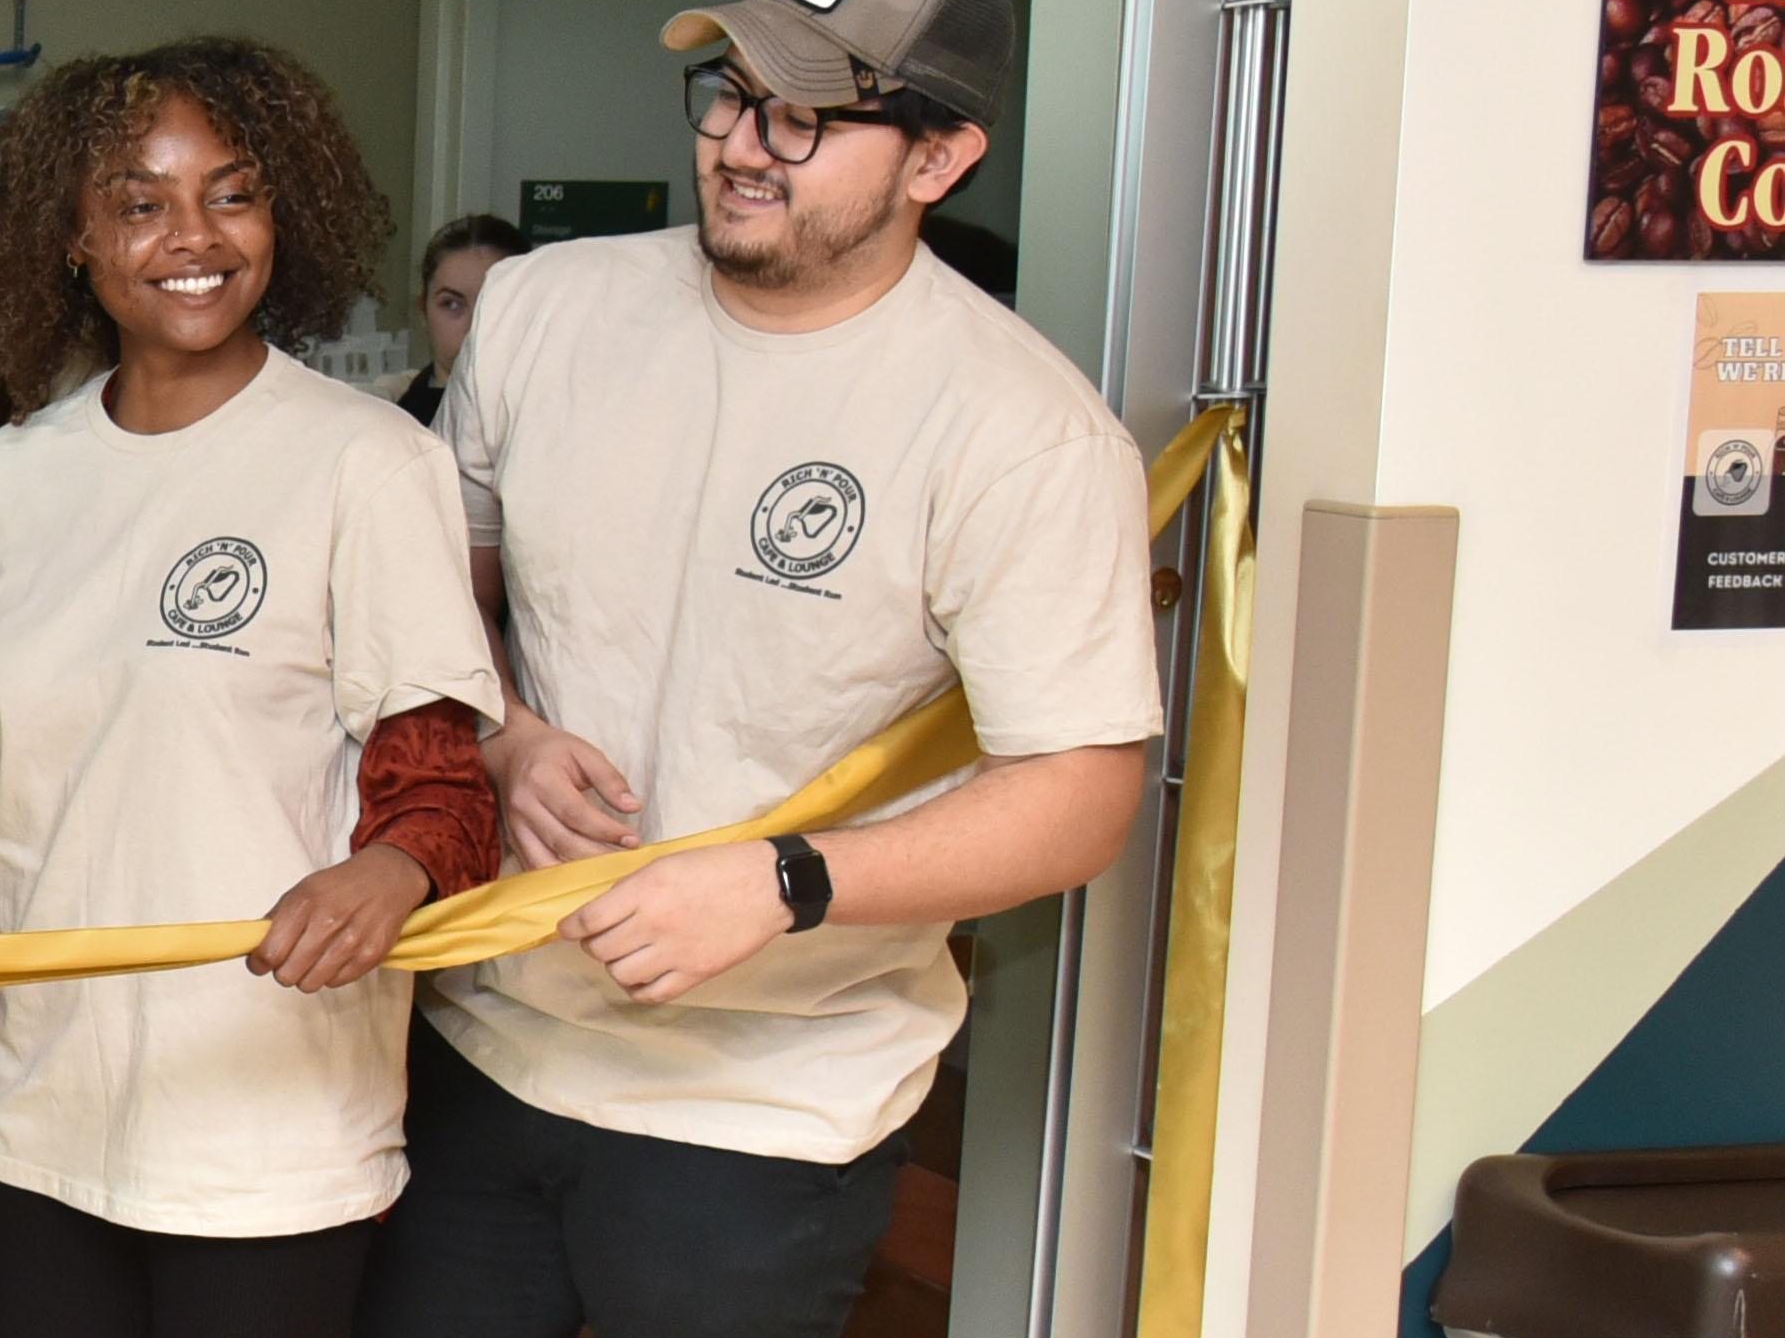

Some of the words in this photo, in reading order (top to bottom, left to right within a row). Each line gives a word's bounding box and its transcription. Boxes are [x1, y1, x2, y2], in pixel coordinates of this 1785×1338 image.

[533, 184, 564, 201] 206
[1719, 336, 1784, 358] TELL
[781, 469, 813, 490] RICH
[833, 473, 858, 504] POUR
[233, 544, 258, 568] POUR
[757, 537, 778, 564] CAFE
[788, 552, 837, 573] LOUNGE
[1707, 550, 1785, 566] CUSTOMER
[1707, 573, 1783, 590] FEEDBACK
[197, 611, 244, 634] LOUNGE
